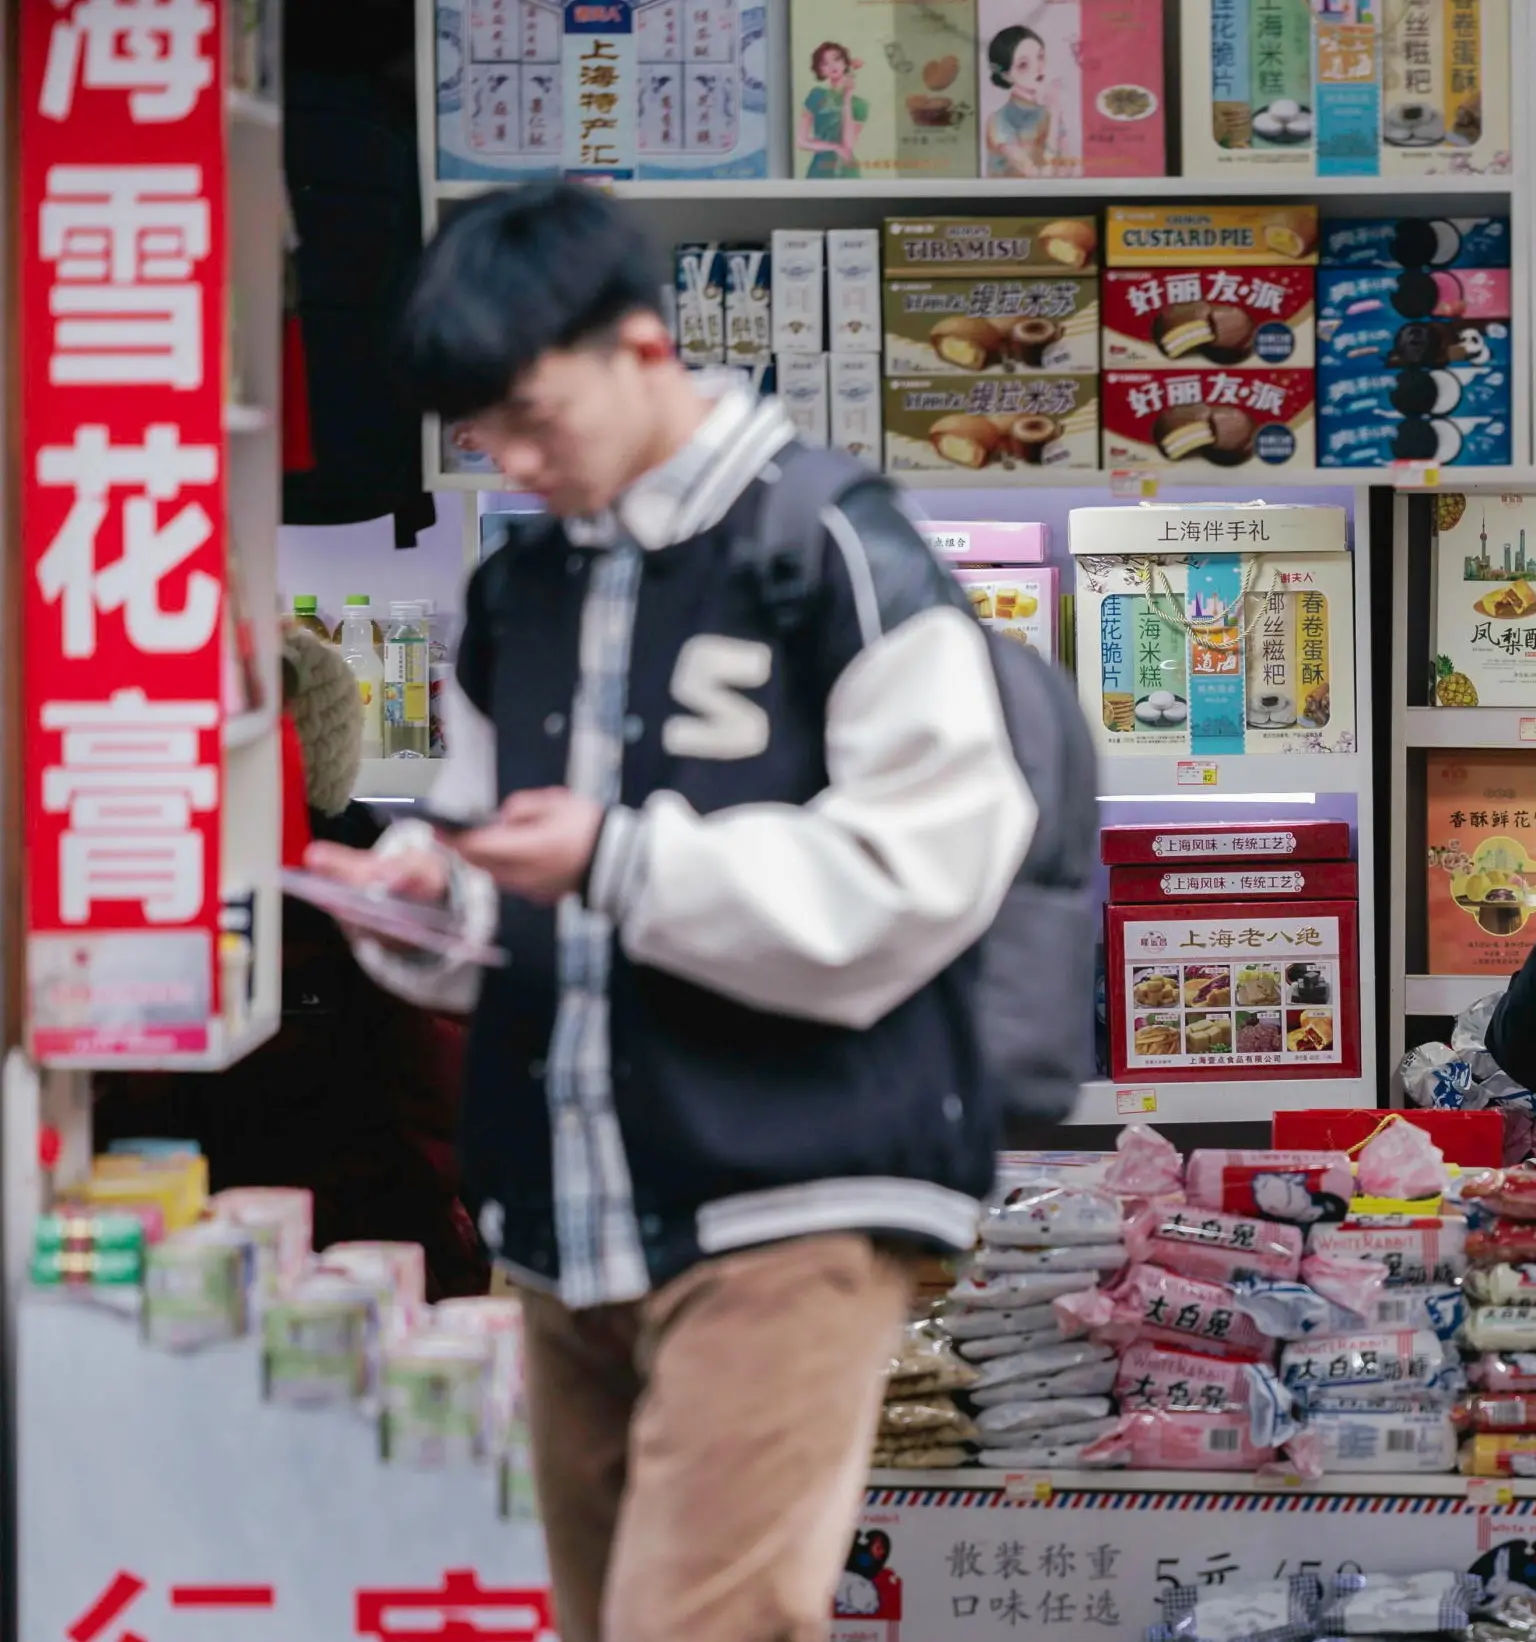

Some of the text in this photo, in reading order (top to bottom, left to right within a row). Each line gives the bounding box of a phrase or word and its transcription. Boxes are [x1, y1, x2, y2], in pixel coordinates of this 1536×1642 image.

[1404, 0, 1432, 95] 丝糍粑
[580, 39, 620, 165] 上海特产汇
[904, 238, 1030, 260] TIRAMISU
[1122, 228, 1255, 247] CUSTARD PIE
[37, 0, 220, 923] 海雪花膏
[926, 536, 966, 548] 点组合
[1157, 518, 1271, 543] 上海伴手礼
[1138, 597, 1162, 689] 上海米糕
[1301, 592, 1325, 685] 春卷蛋酥
[662, 634, 772, 760] S
[1179, 926, 1323, 949] 上海老八绝
[1161, 1212, 1257, 1248] 大白兔
[1144, 1295, 1234, 1338] 大白兔
[1127, 1374, 1226, 1408] 大白兔
[944, 1539, 1122, 1581] 散装称重
[952, 1588, 1123, 1628] 口味任选
